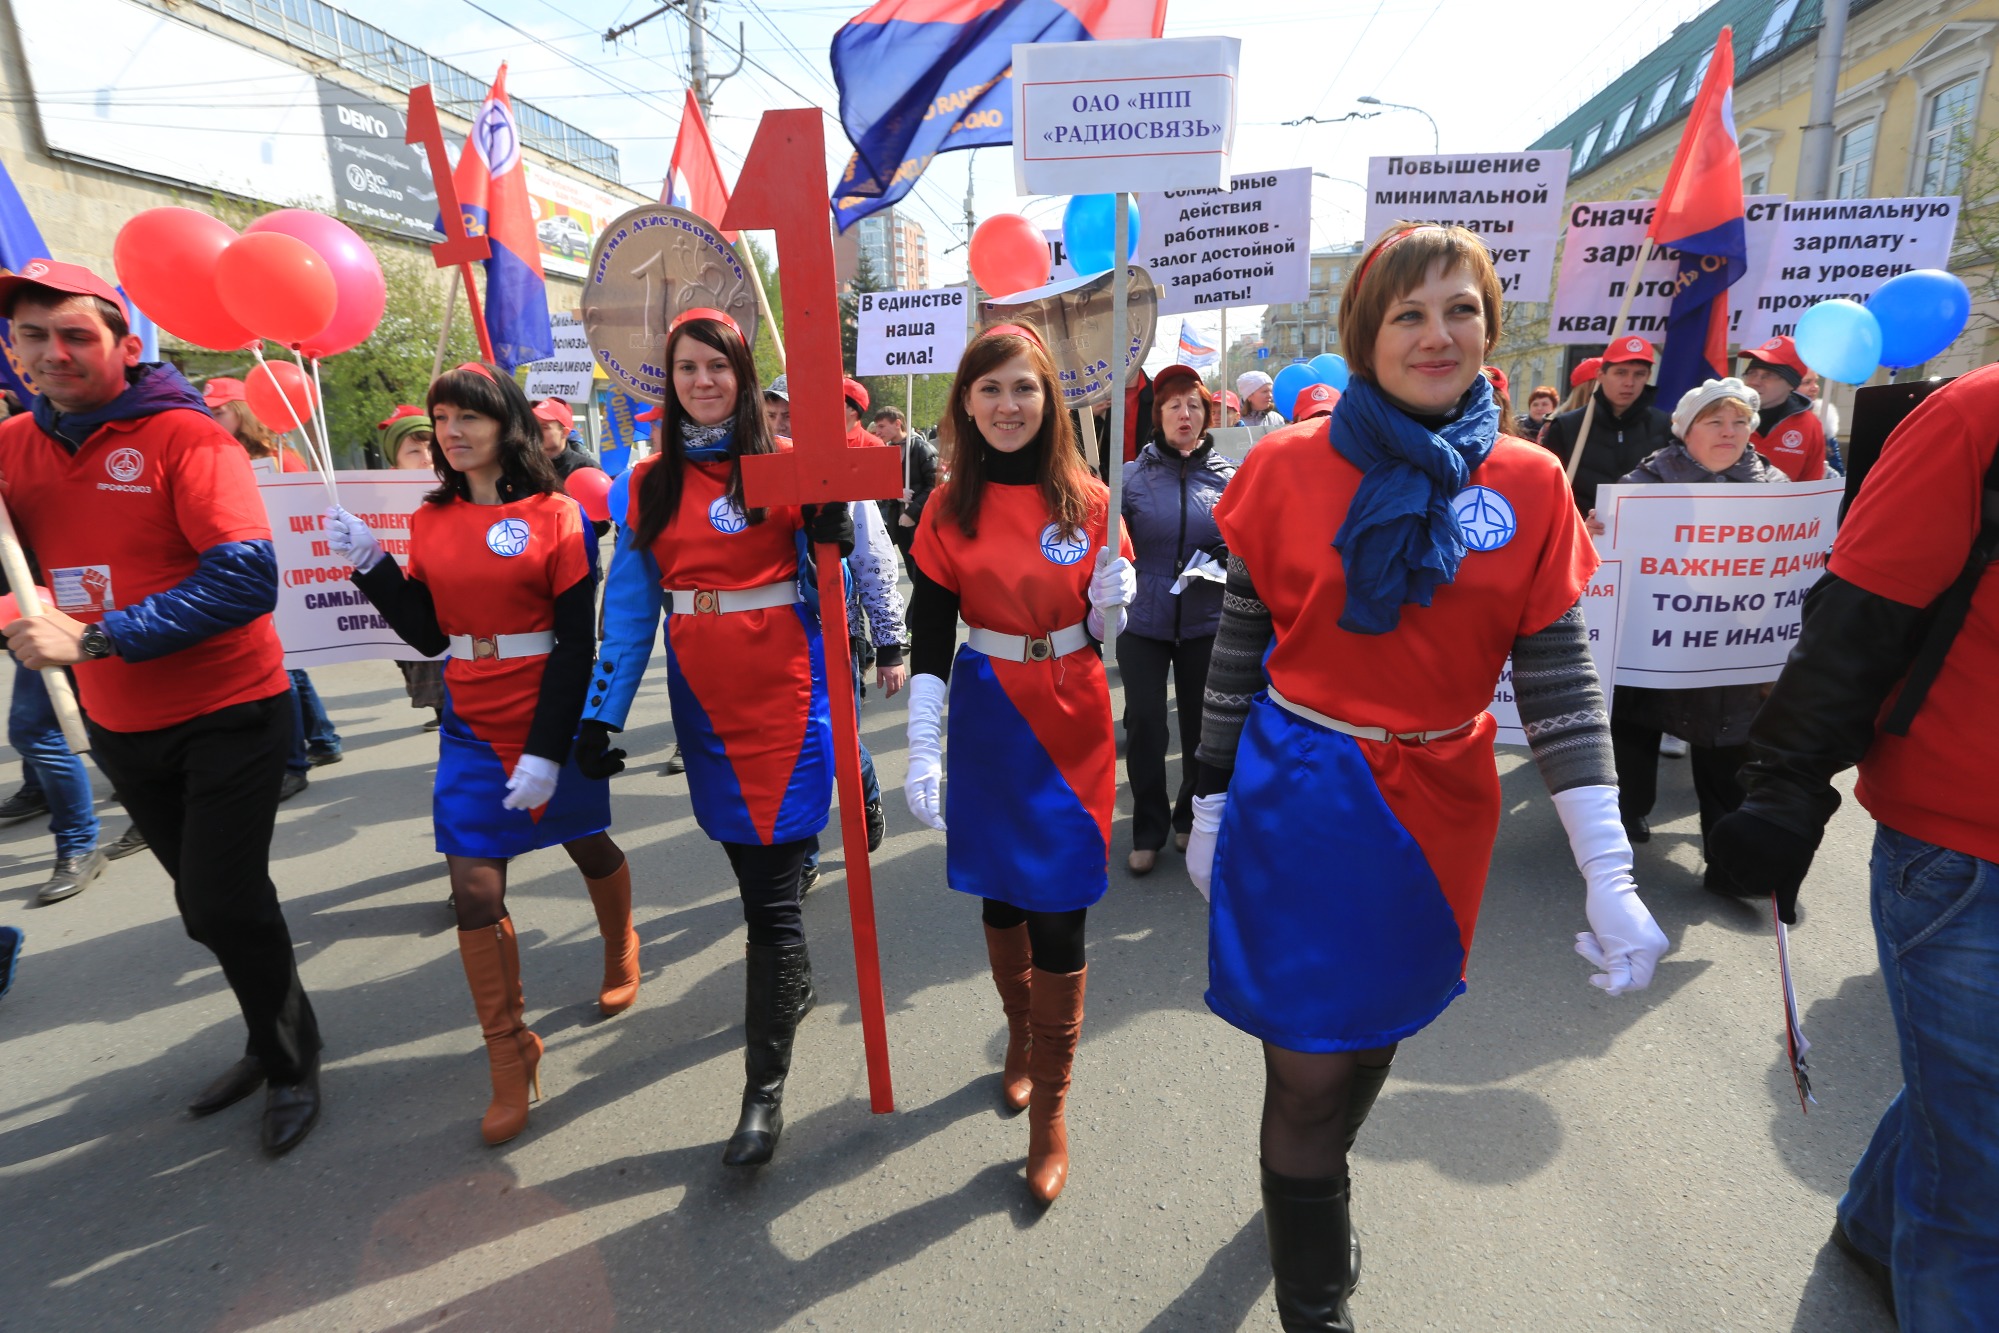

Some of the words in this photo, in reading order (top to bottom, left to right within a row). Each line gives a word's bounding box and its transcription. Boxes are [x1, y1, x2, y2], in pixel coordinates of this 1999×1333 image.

[1072, 94, 1120, 113] ОАО
[1127, 90, 1192, 109] «НПП
[1043, 119, 1222, 144] «РАДИОСВЯЗЬ»
[1388, 157, 1541, 176] Повышение
[1375, 183, 1549, 205] минимальной
[1179, 200, 1262, 222] действия
[1164, 222, 1270, 247] работников
[1793, 233, 1904, 254] зарплату
[595, 228, 628, 285] ВРЕМЯ
[632, 214, 743, 282] ДЕЙСТВОВАТЬ
[1150, 252, 1198, 269] залог
[1201, 237, 1296, 264] достойной
[1171, 261, 1275, 288] заработной
[1781, 264, 1811, 281] на
[862, 295, 873, 312] В
[878, 292, 963, 312] единстве
[1194, 286, 1252, 305] платы!
[886, 322, 935, 337] наша
[885, 346, 933, 366] сила!
[97, 482, 151, 494] ПРОФСОЮЗ
[289, 515, 315, 534] ЦК
[1674, 517, 1820, 544] ПЕРВОМАЙ
[1640, 557, 1765, 577] ВАЖНЕЕ
[1652, 593, 1765, 613] ТОЛЬКО
[1652, 629, 1672, 647] И
[1683, 630, 1719, 648] НЕ
